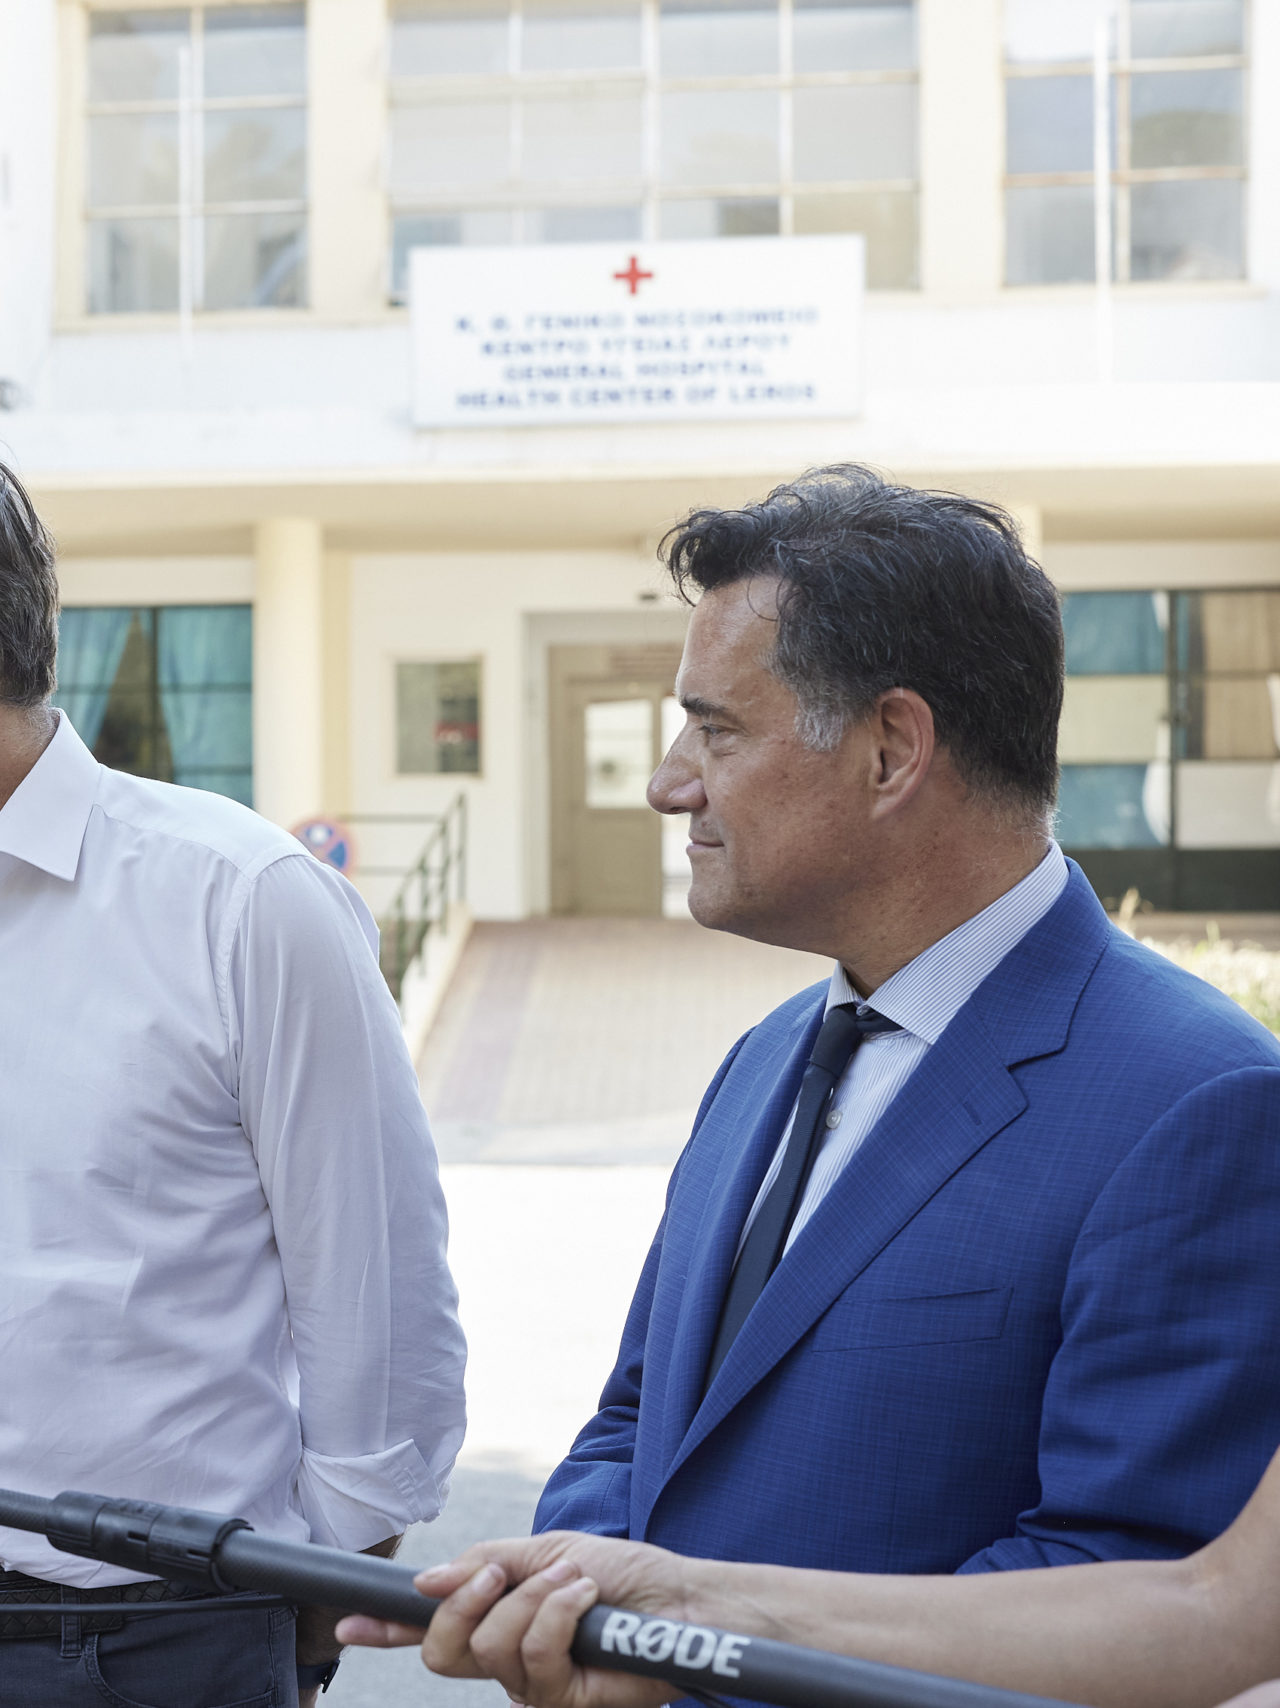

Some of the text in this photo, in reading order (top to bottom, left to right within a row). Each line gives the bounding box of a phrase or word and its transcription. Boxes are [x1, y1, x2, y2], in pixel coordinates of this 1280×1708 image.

[505, 360, 763, 382] GENERAL HOSPITAL
[456, 383, 816, 409] HEALTH CENTER OF LEROS
[600, 1610, 751, 1678] RØDE
